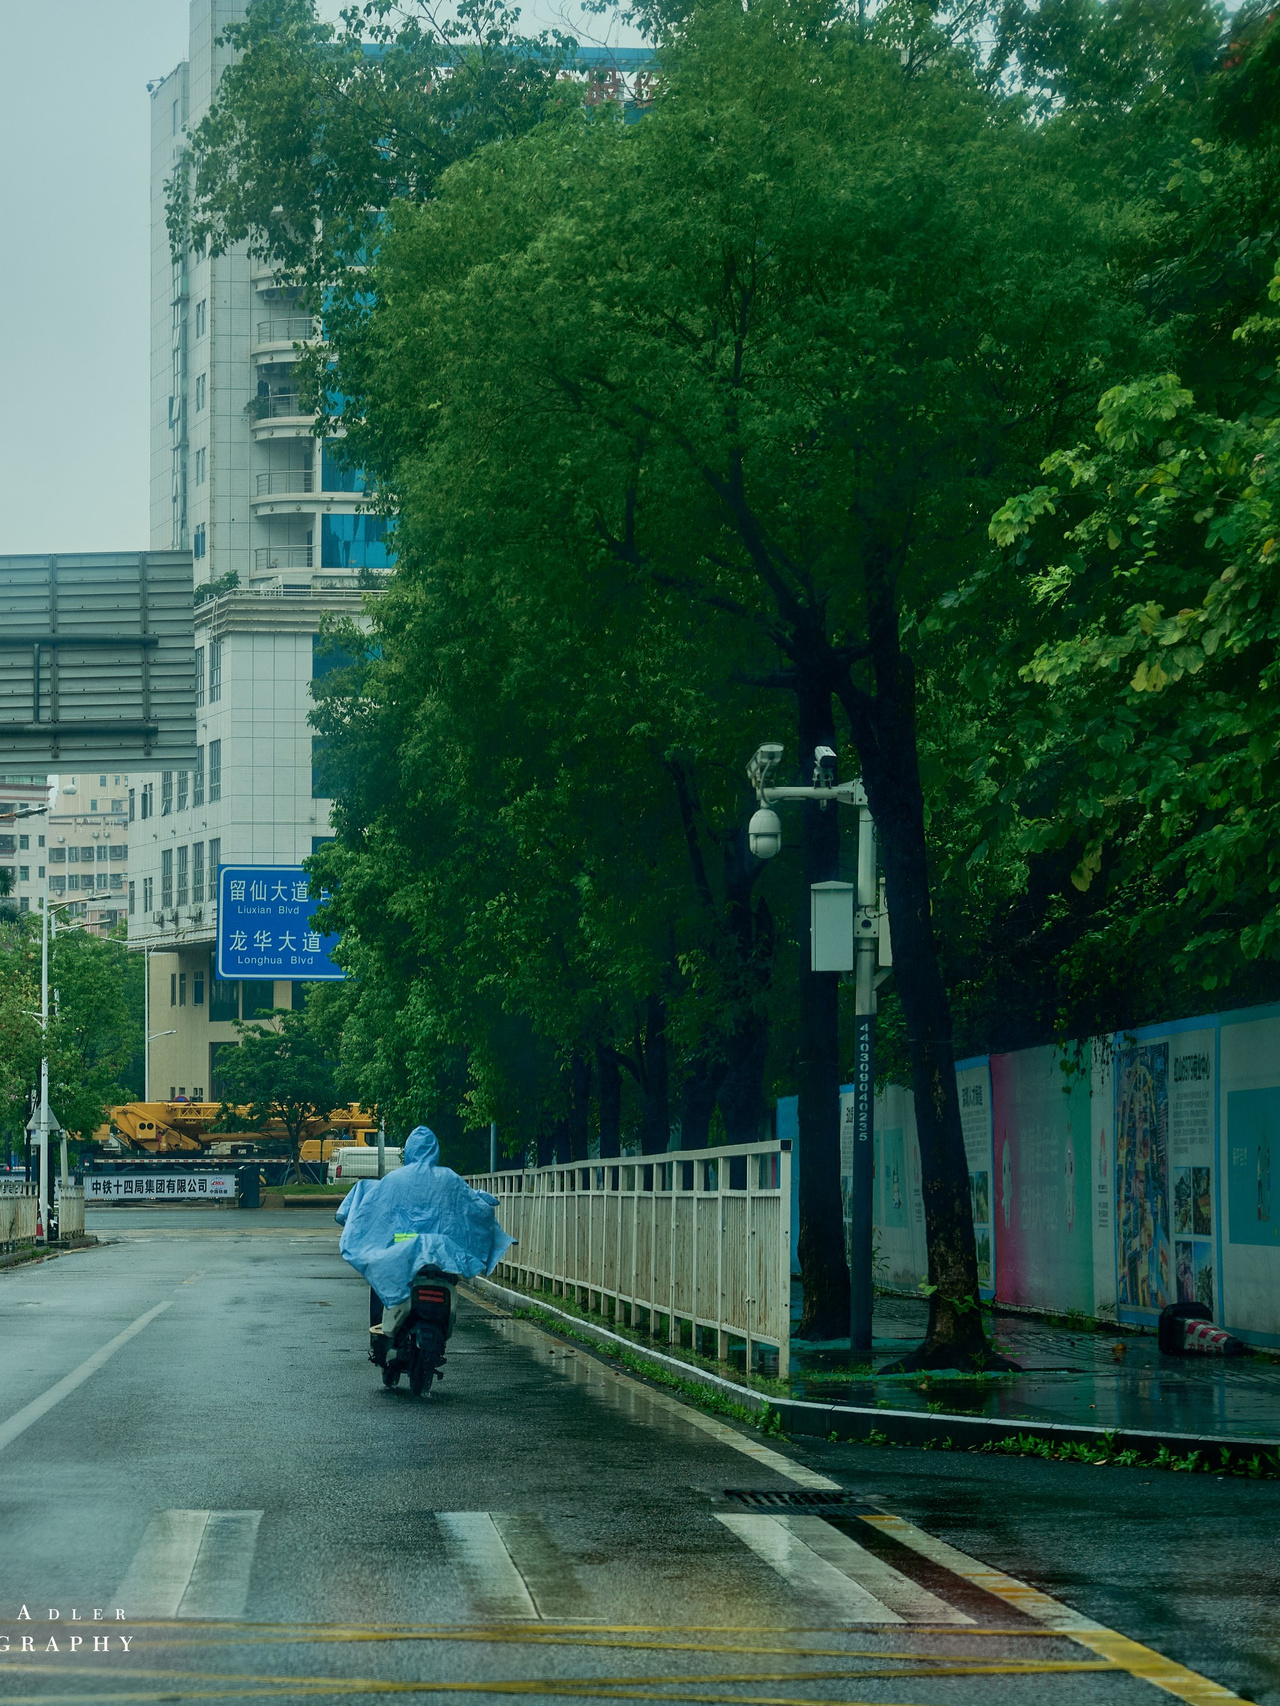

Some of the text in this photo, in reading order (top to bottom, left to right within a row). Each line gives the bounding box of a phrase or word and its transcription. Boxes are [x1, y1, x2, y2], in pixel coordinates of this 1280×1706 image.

[230, 879, 309, 902] 留仙大道
[237, 905, 300, 915] Liuxian Blvd
[228, 930, 322, 953] 龙华大道
[237, 956, 314, 967] Longhua Blvd
[858, 1022, 870, 1141] 440309040235
[92, 1178, 208, 1195] 中铁十四局集团有限公司
